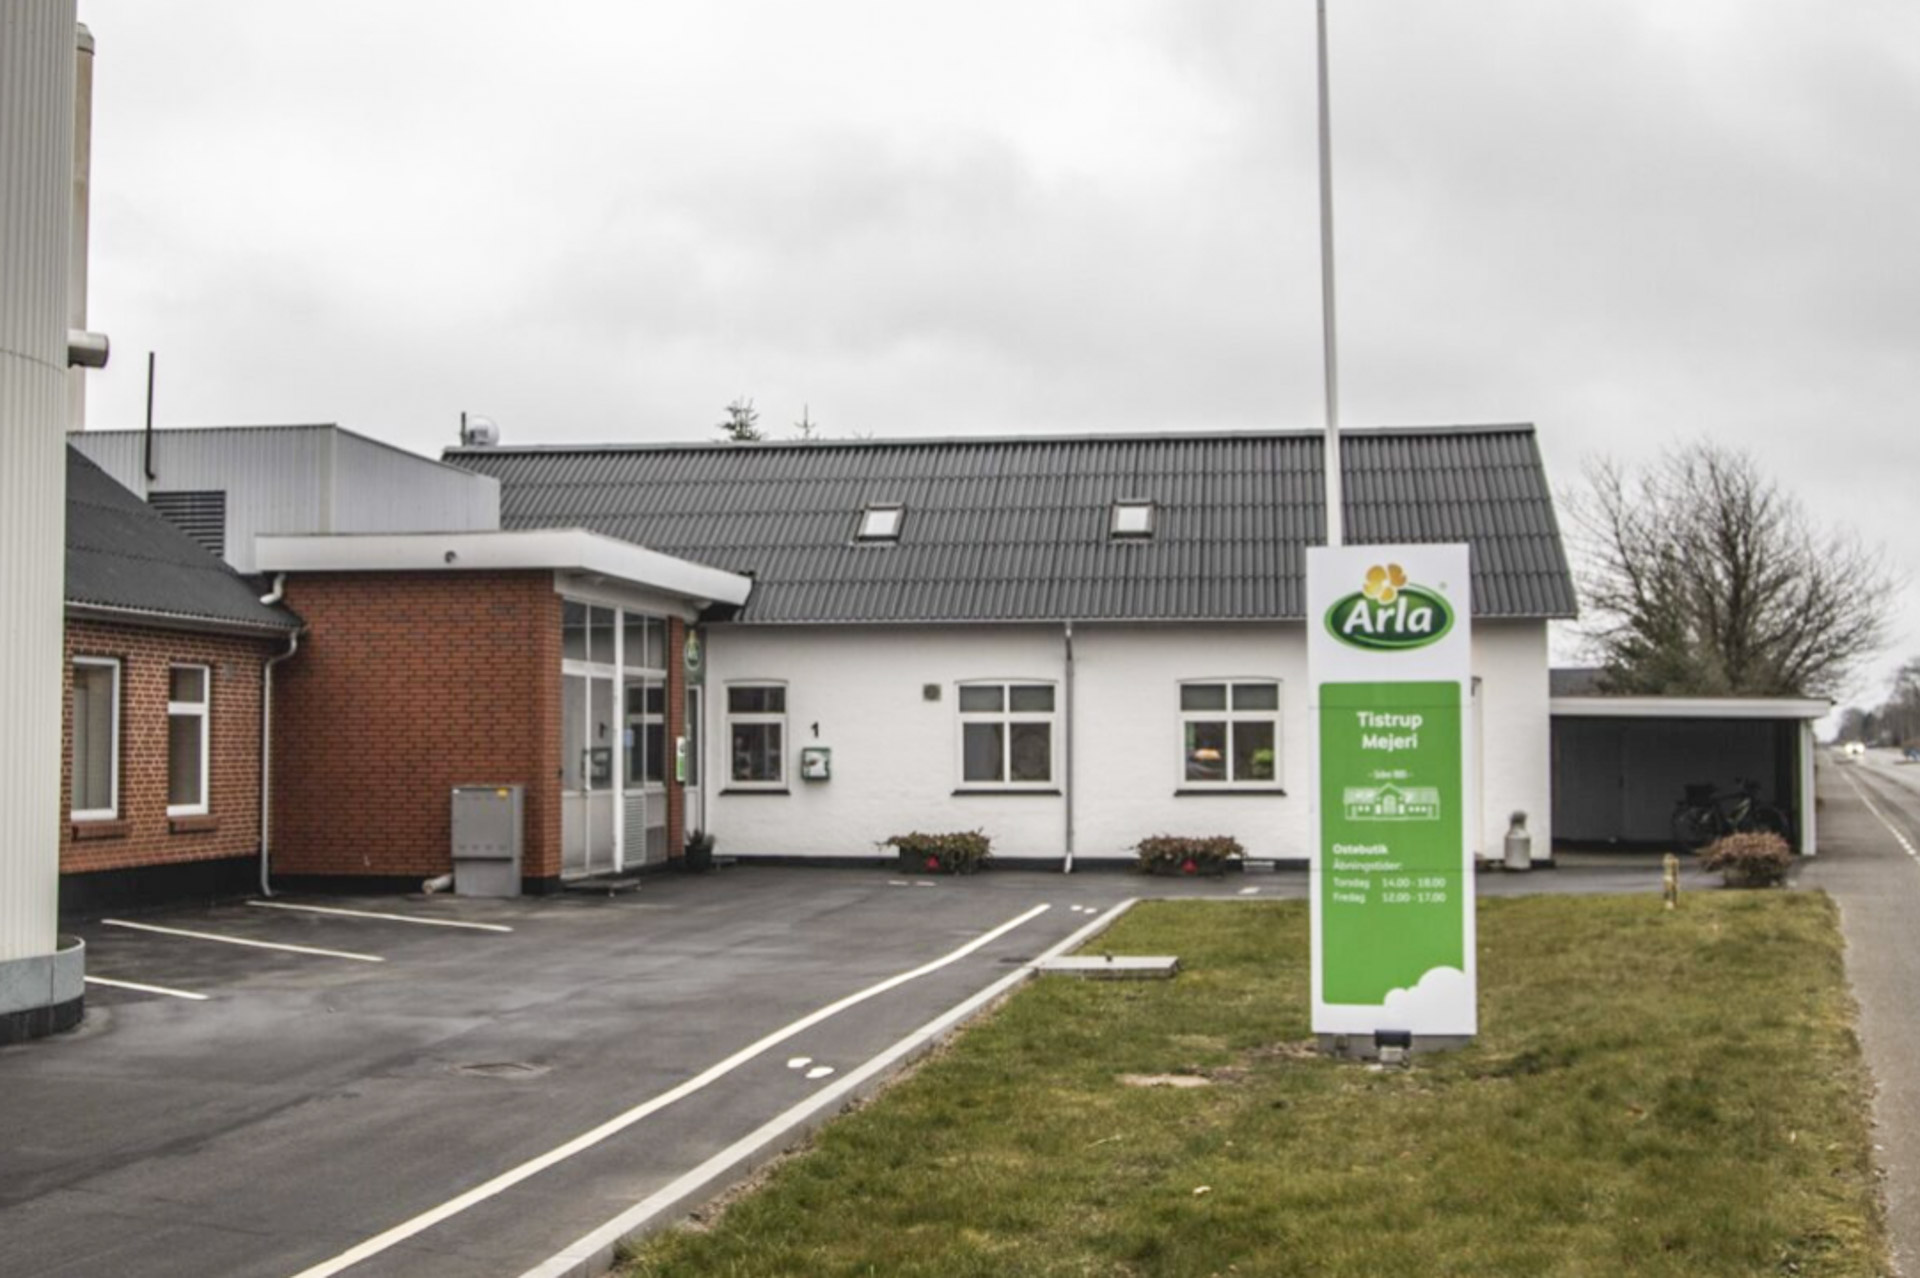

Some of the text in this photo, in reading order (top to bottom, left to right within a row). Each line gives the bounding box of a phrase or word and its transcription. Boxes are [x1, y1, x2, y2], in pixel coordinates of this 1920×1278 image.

[1342, 596, 1433, 634] Arla
[1356, 711, 1423, 730] Tistrup
[810, 721, 819, 739] 1
[1362, 733, 1418, 752] Mejeri
[1332, 844, 1389, 855] Ostebutik
[1333, 892, 1366, 904] Fredag
